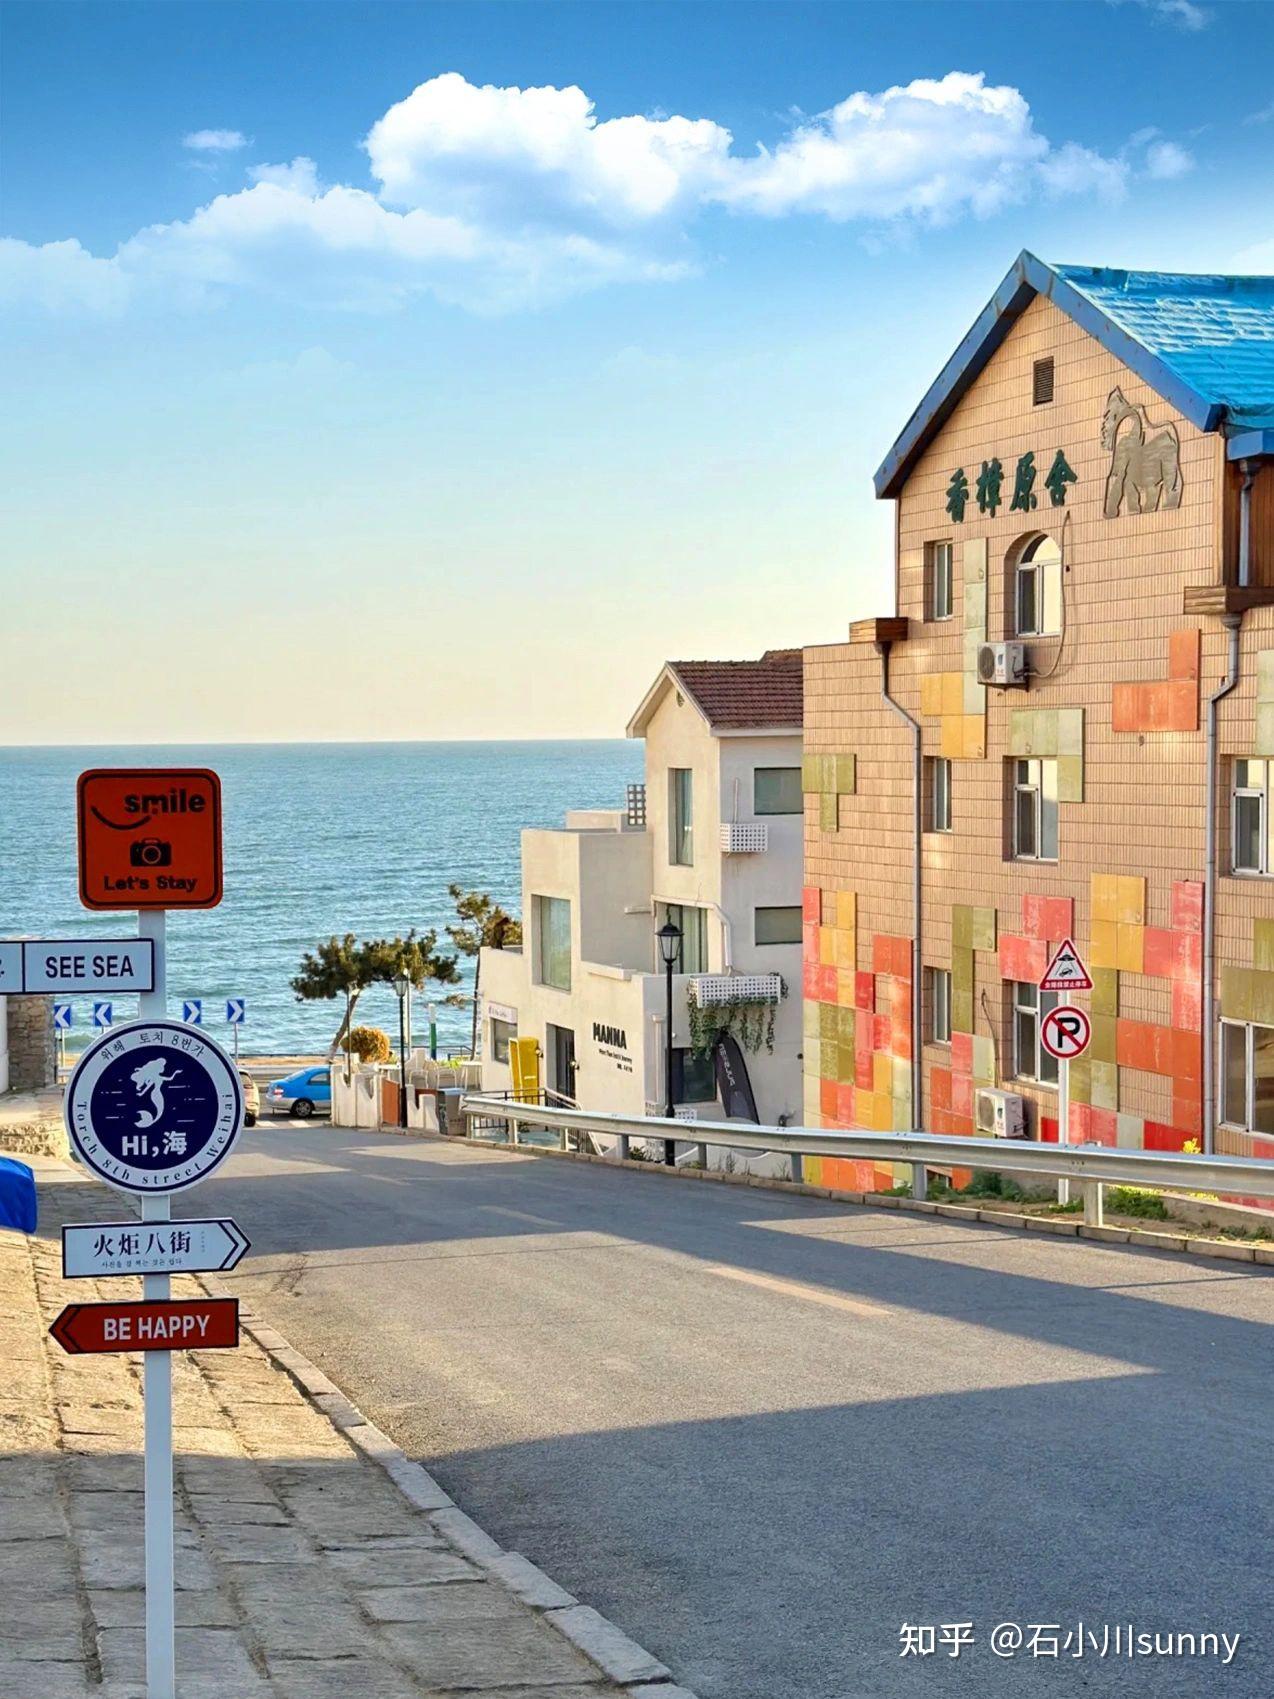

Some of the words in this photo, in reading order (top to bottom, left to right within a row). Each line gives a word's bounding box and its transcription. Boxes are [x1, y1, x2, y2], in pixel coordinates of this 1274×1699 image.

[124, 788, 206, 814] smile
[104, 876, 149, 891] Let's
[156, 876, 198, 892] Stay
[45, 956, 86, 978] SEE
[92, 955, 134, 978] SEA
[140, 1031, 163, 1044] 토치
[77, 1101, 98, 1155] Torch
[102, 1159, 130, 1181] 8th
[142, 1162, 202, 1184] street
[206, 1094, 233, 1157] Weihai
[93, 1231, 191, 1257] 火炬八街
[104, 1317, 131, 1341] BE
[138, 1314, 210, 1340] HAPPY
